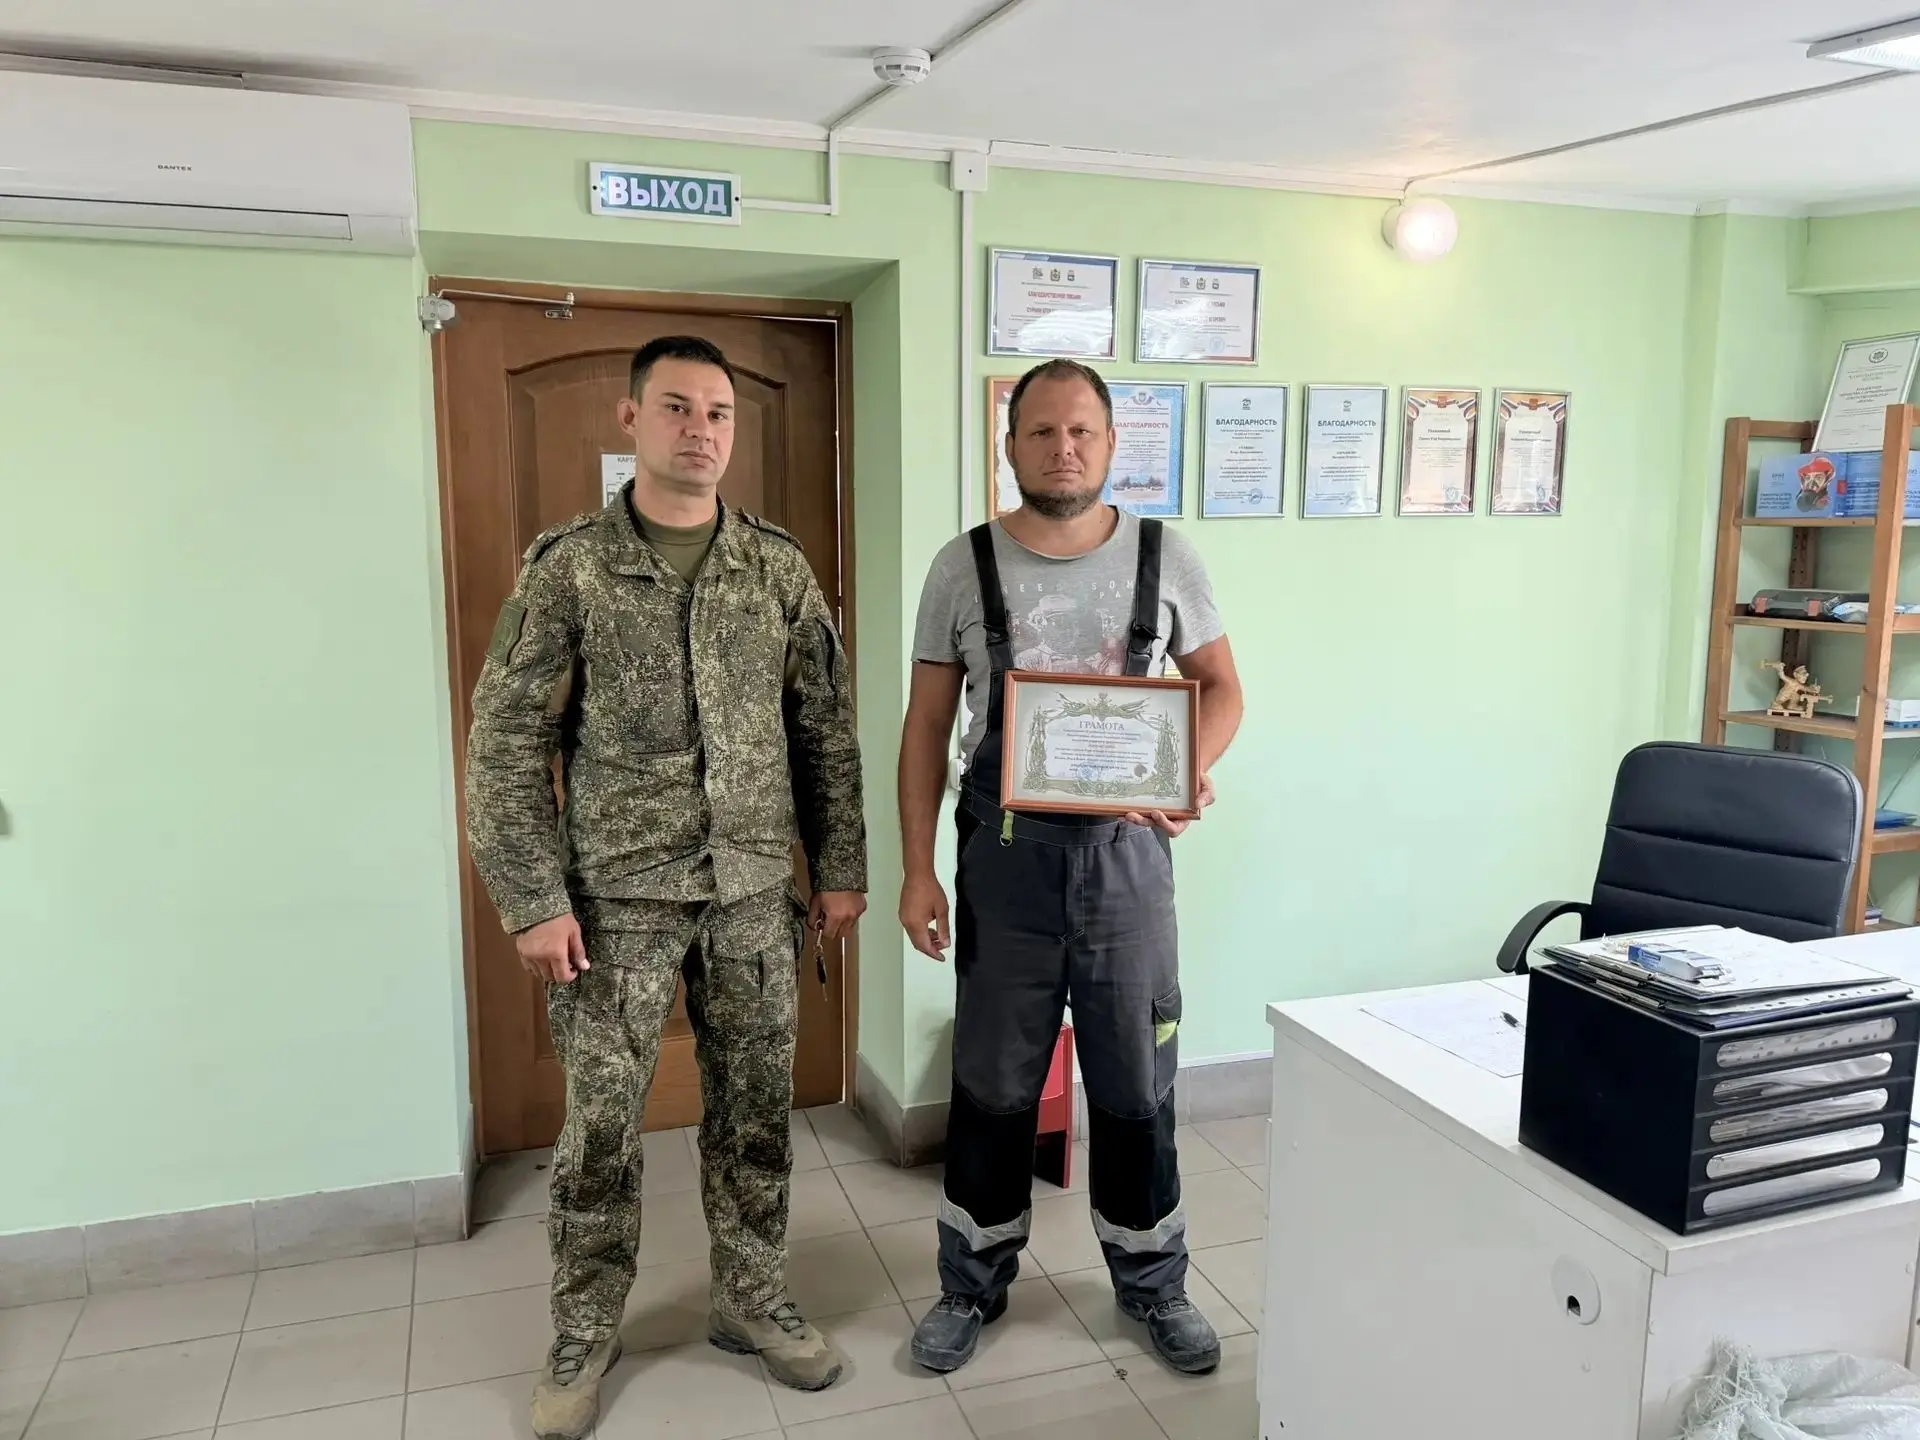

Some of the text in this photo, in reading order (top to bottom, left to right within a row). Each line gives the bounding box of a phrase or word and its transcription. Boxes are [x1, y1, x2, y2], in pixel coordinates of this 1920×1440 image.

[157, 164, 192, 172] DANTEX
[608, 175, 727, 215] ВЫХОД
[1114, 421, 1169, 429] БЛАГОДАРНОСТЬ
[1215, 418, 1278, 426] БЛАГОДАРНОСТЬ
[1091, 580, 1134, 591] SOM
[1079, 720, 1125, 731] ГРАМОТА
